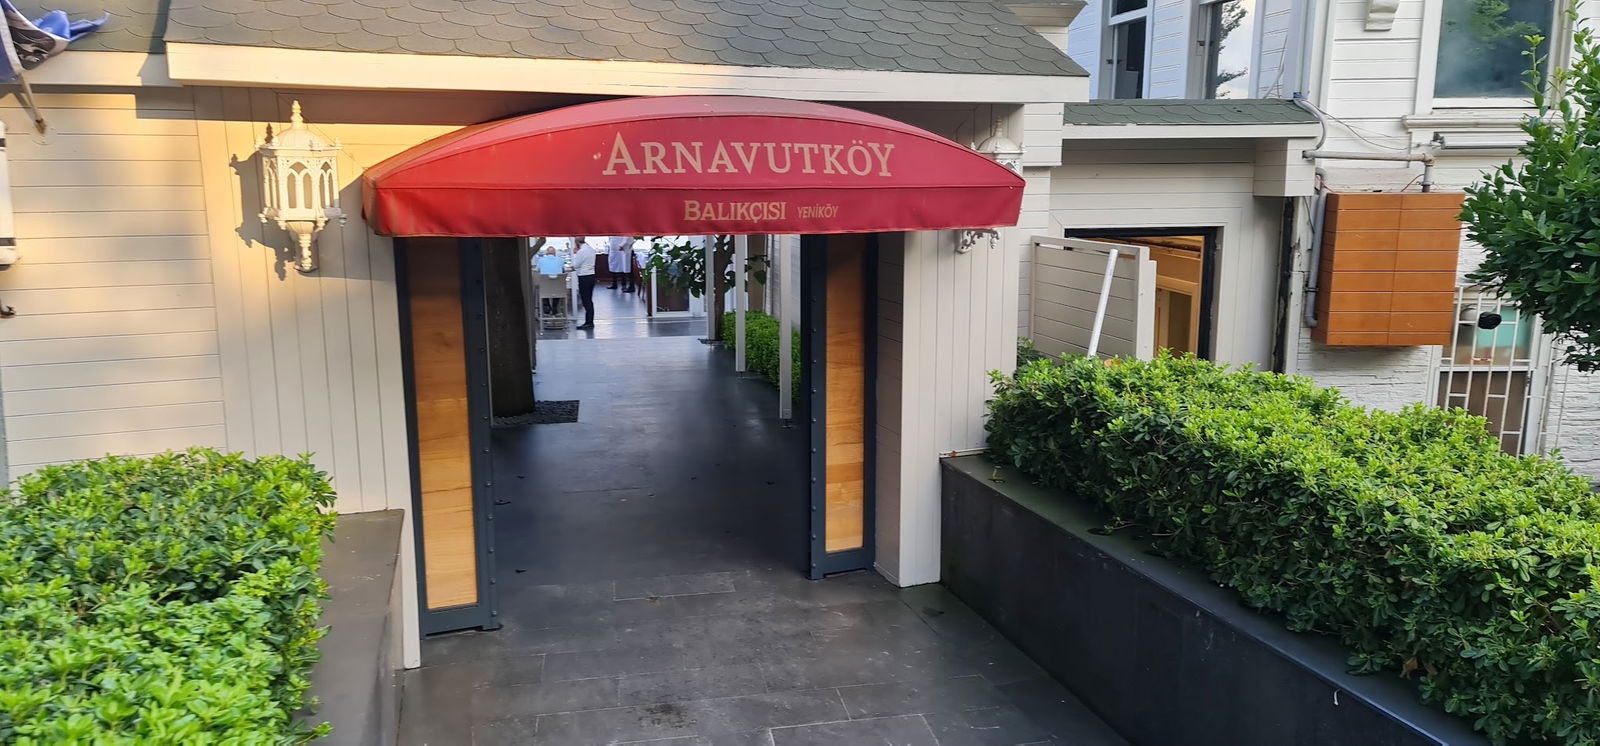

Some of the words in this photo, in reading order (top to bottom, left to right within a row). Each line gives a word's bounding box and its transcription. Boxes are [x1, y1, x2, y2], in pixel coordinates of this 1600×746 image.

[602, 132, 895, 176] ARNAVUTKÖY
[683, 200, 787, 223] BALIKÇISI
[797, 203, 839, 219] YENİKÖY
